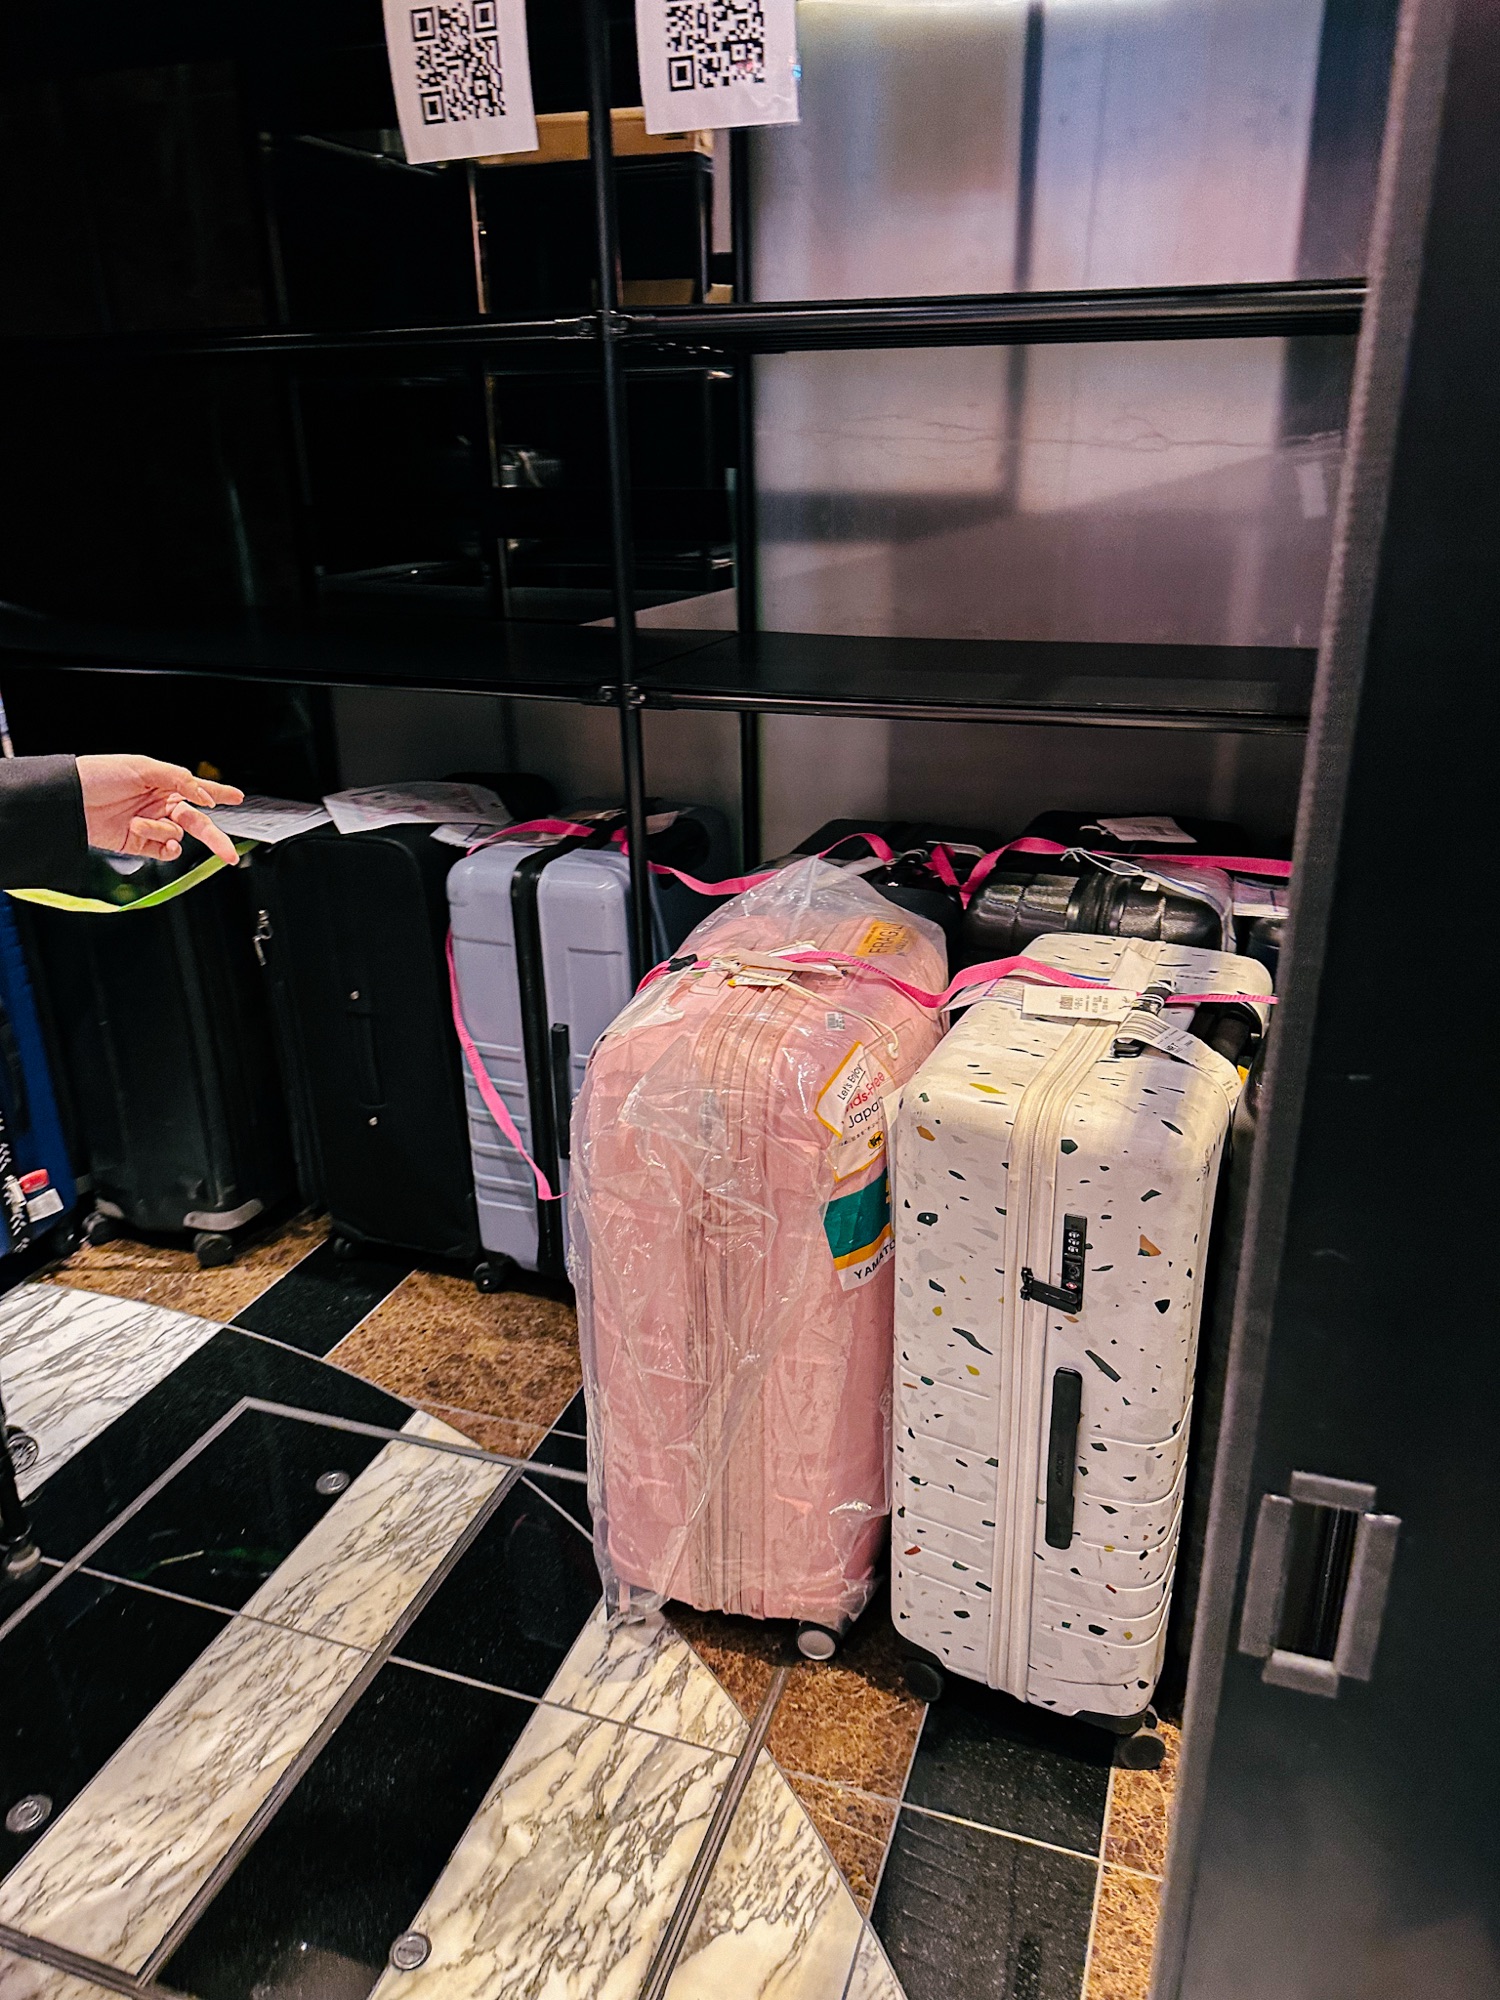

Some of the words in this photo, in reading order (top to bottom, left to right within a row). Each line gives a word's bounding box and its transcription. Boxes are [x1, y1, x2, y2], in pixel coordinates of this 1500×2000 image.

[837, 1083, 853, 1101] Let's
[847, 1063, 864, 1083] Enjoy
[853, 1239, 896, 1280] YAMATO
